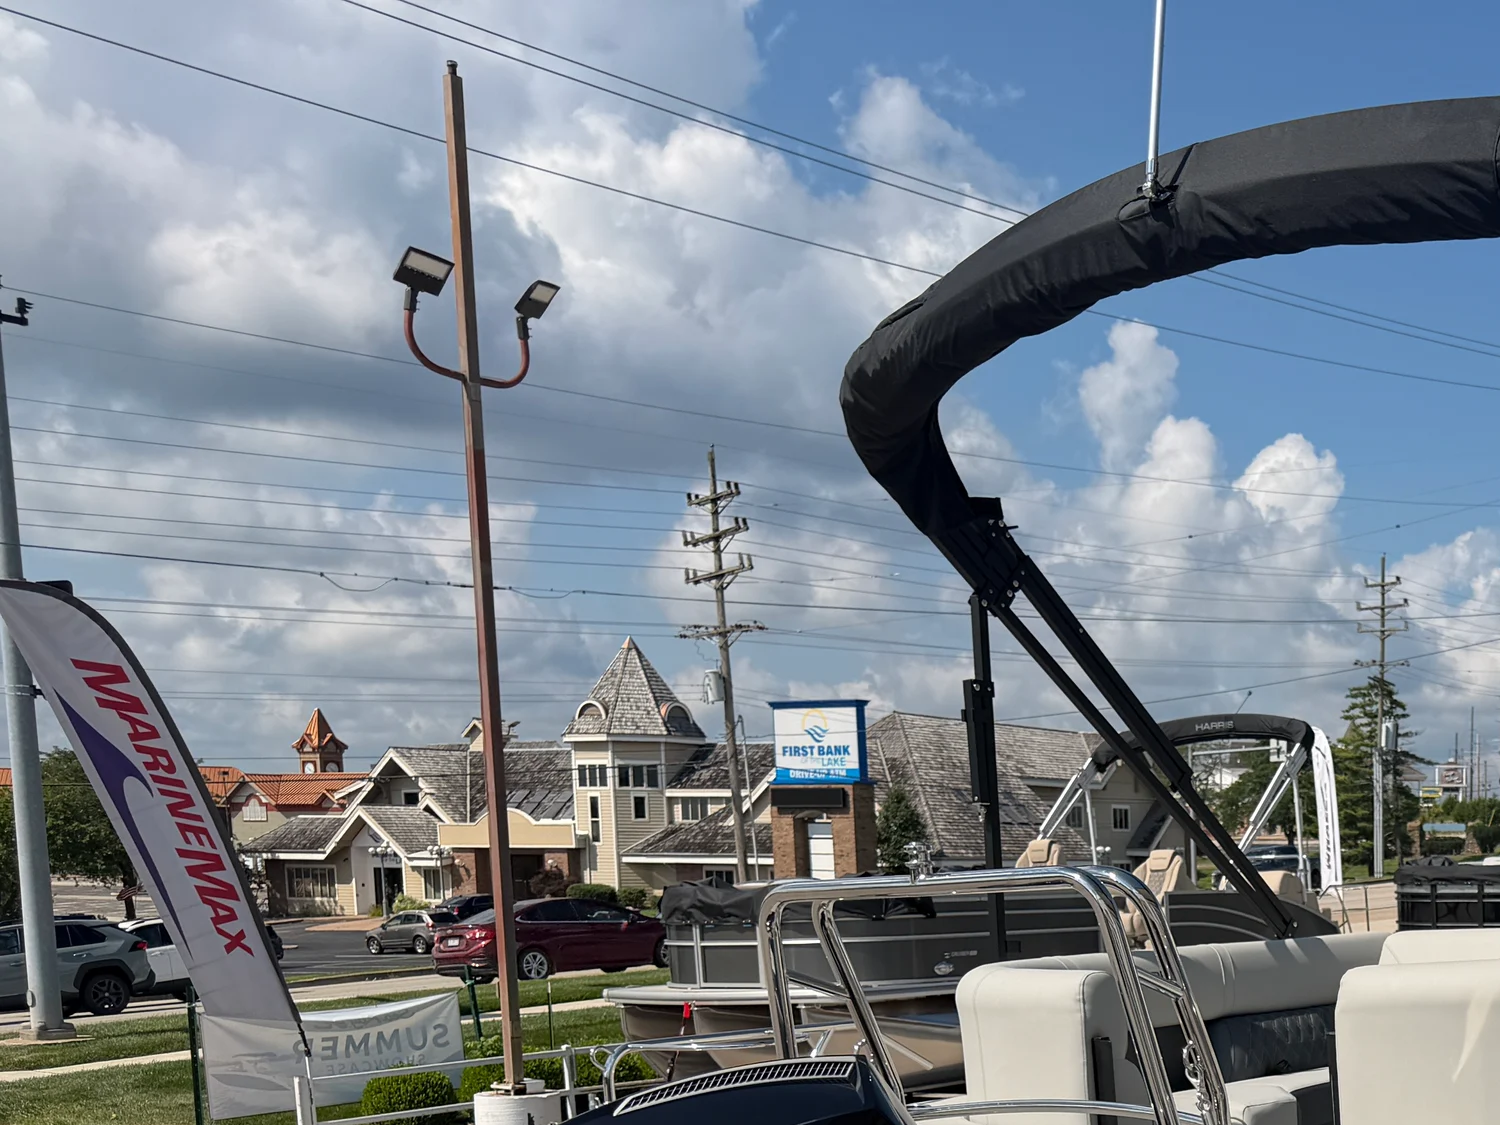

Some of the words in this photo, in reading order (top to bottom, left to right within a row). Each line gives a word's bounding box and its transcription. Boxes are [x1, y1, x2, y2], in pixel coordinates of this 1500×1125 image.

[1195, 720, 1234, 731] HARRIS
[782, 745, 815, 757] FIRST
[818, 745, 851, 756] BANK
[821, 756, 847, 767] LAKE
[70, 658, 255, 957] MARINEMAX
